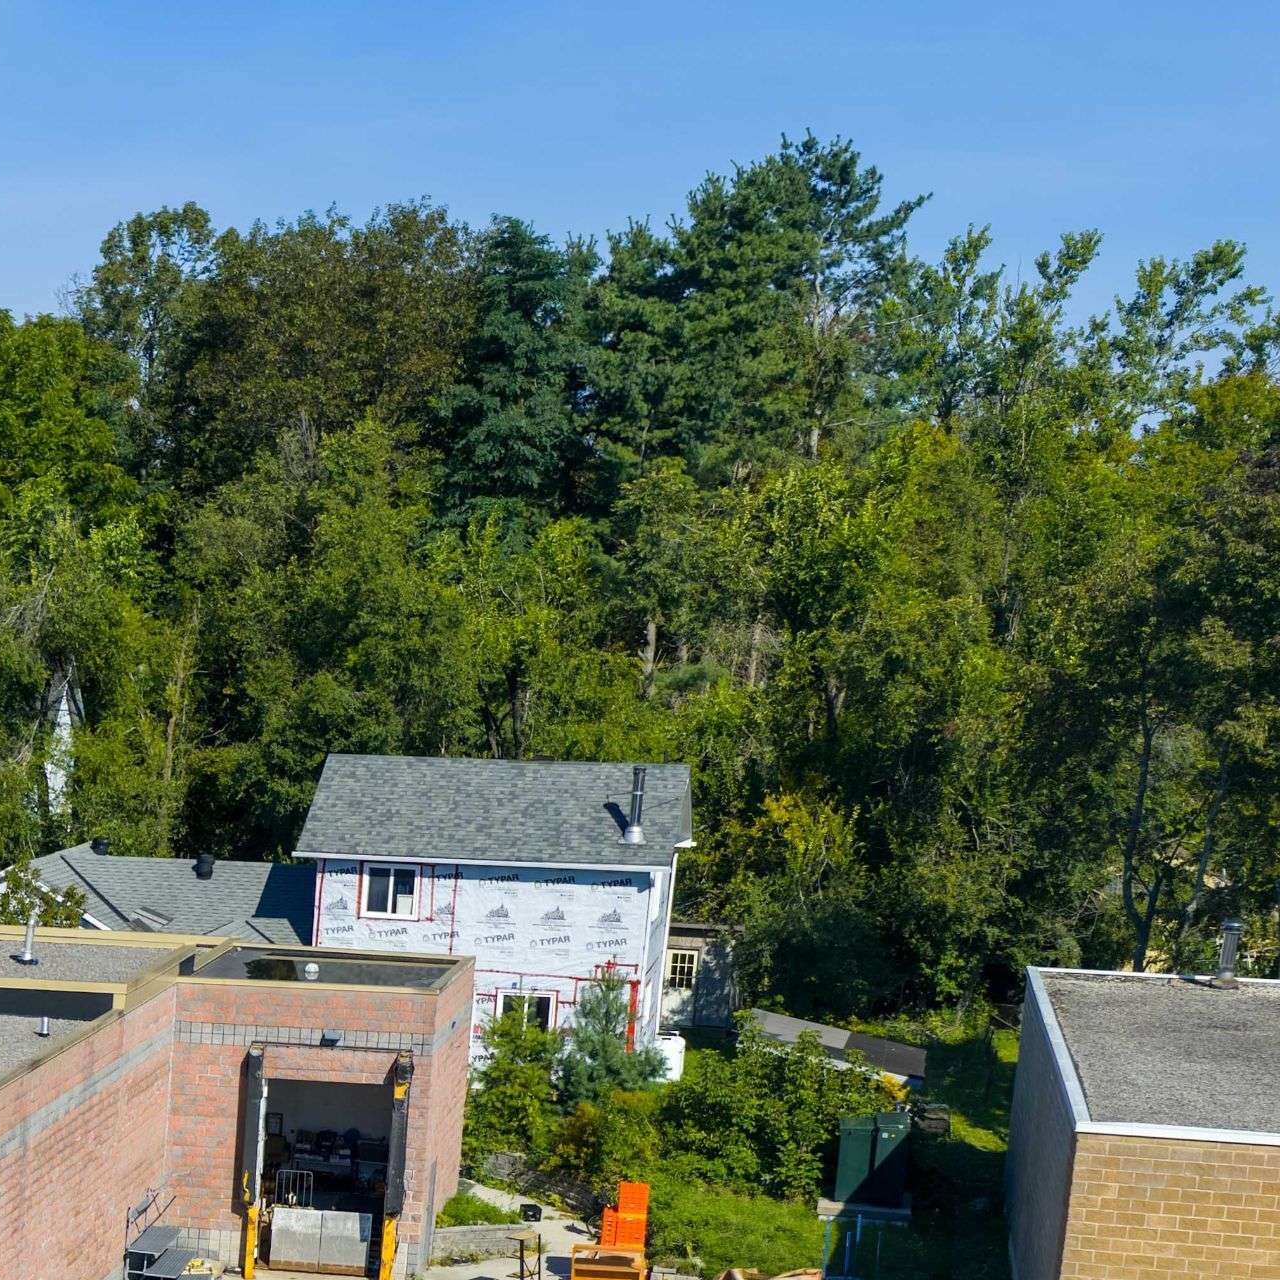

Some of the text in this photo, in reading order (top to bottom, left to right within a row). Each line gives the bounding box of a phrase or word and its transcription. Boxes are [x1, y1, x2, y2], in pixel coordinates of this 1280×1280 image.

[328, 866, 357, 877] TYPAR
[489, 873, 519, 884] TYPAR
[544, 875, 576, 886] TYPAR
[600, 878, 632, 888] TYPAR
[324, 925, 354, 936] TYPAR
[377, 928, 409, 939] TYPAR
[484, 933, 515, 944] TYPAR
[539, 935, 571, 947] TYPAR
[596, 938, 627, 949] TYPAR
[471, 1052, 495, 1063] YPA
